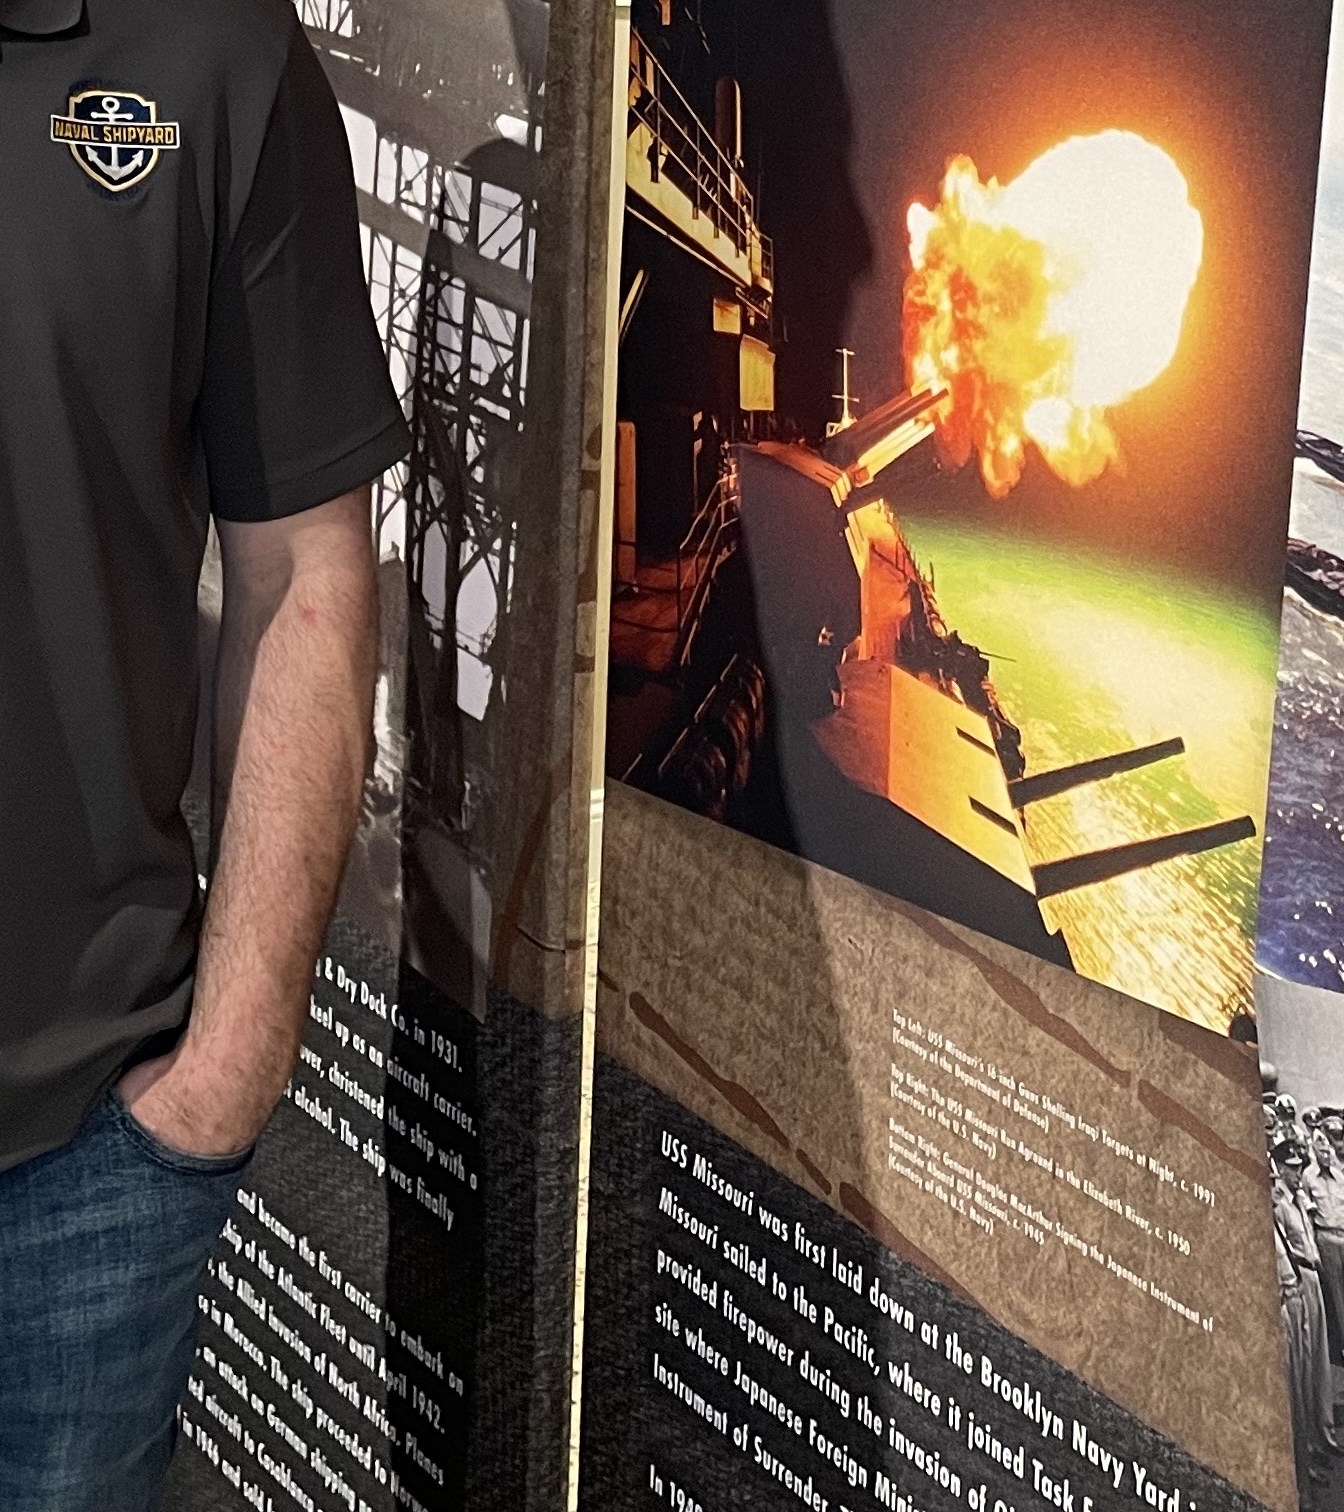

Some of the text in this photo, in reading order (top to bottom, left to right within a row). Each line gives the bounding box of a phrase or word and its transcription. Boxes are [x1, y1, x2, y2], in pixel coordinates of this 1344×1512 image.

[55, 120, 174, 144] NAVAL SHIPYARD
[658, 1187, 1074, 1512] Missouri sailed to the Pacific, where it joined Task
[661, 1130, 1180, 1512] USS Missouri was first laid down at the Brooklyn Navy Yard
